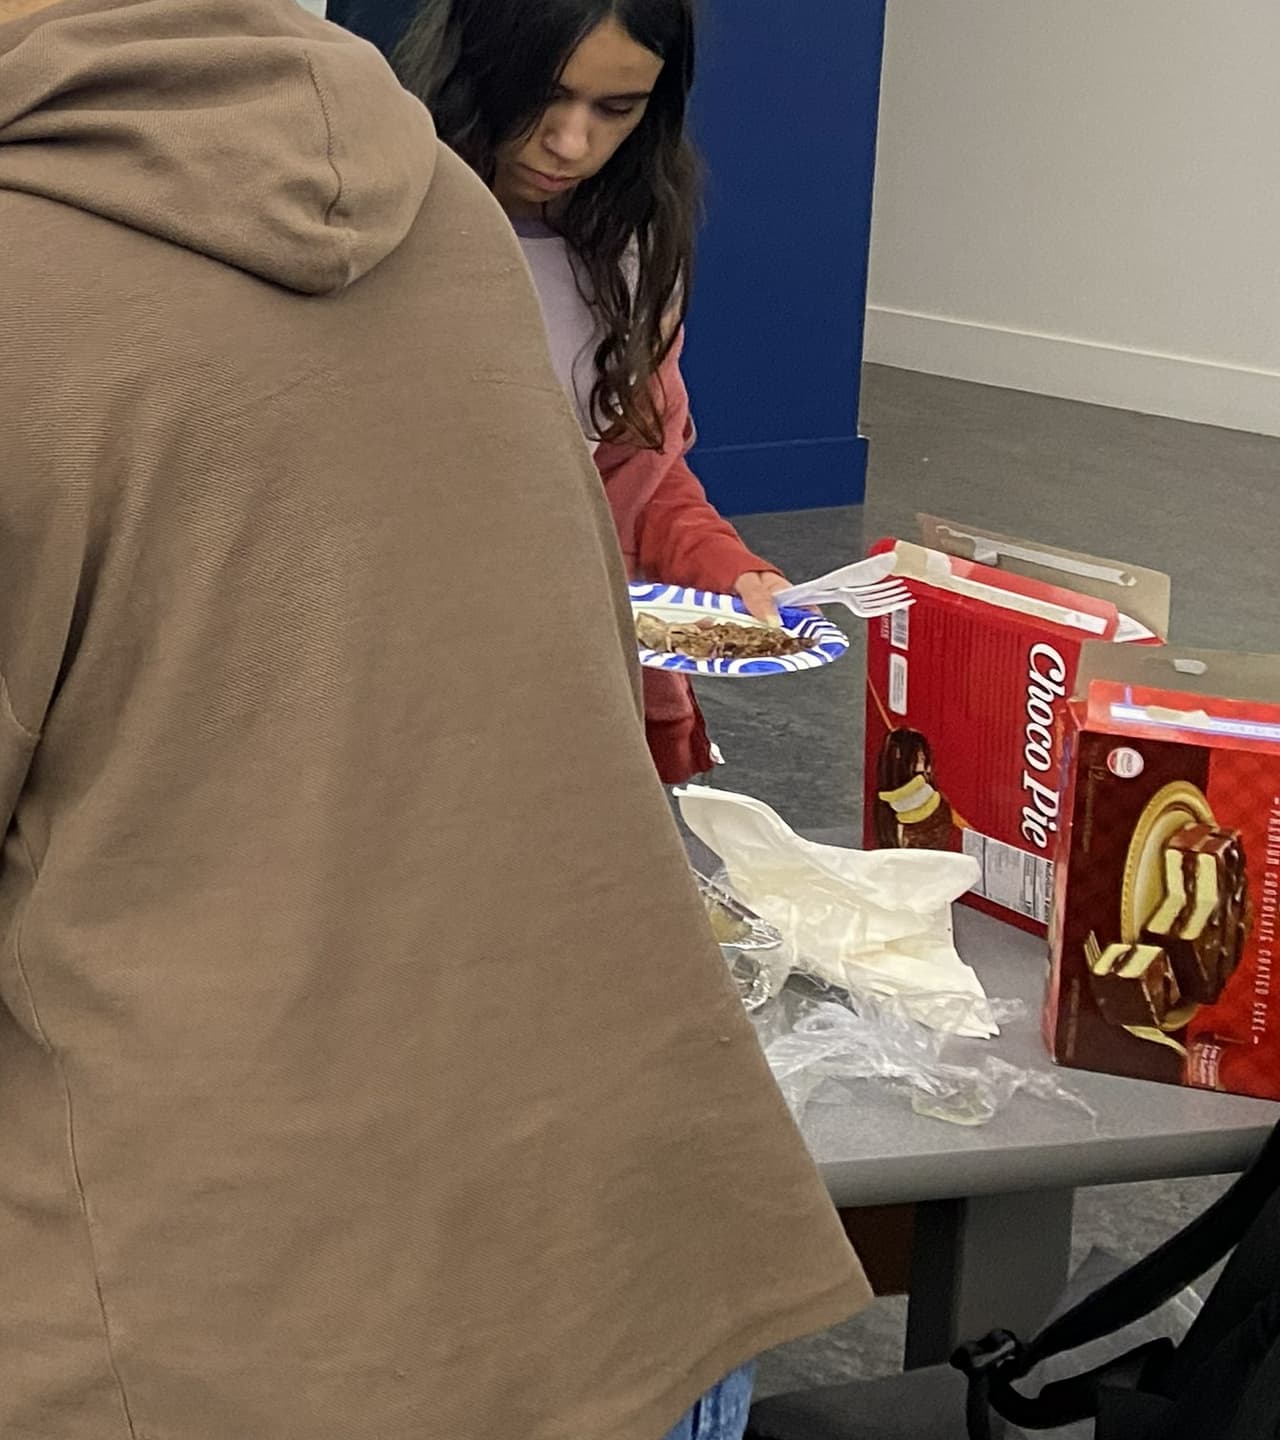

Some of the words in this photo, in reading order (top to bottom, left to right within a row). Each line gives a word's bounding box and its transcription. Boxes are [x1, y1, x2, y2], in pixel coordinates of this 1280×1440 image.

[1024, 643, 1066, 772] Choco
[1022, 770, 1060, 848] Pie
[1260, 872, 1278, 943] CHOCOLATE
[1254, 947, 1271, 995] COATED
